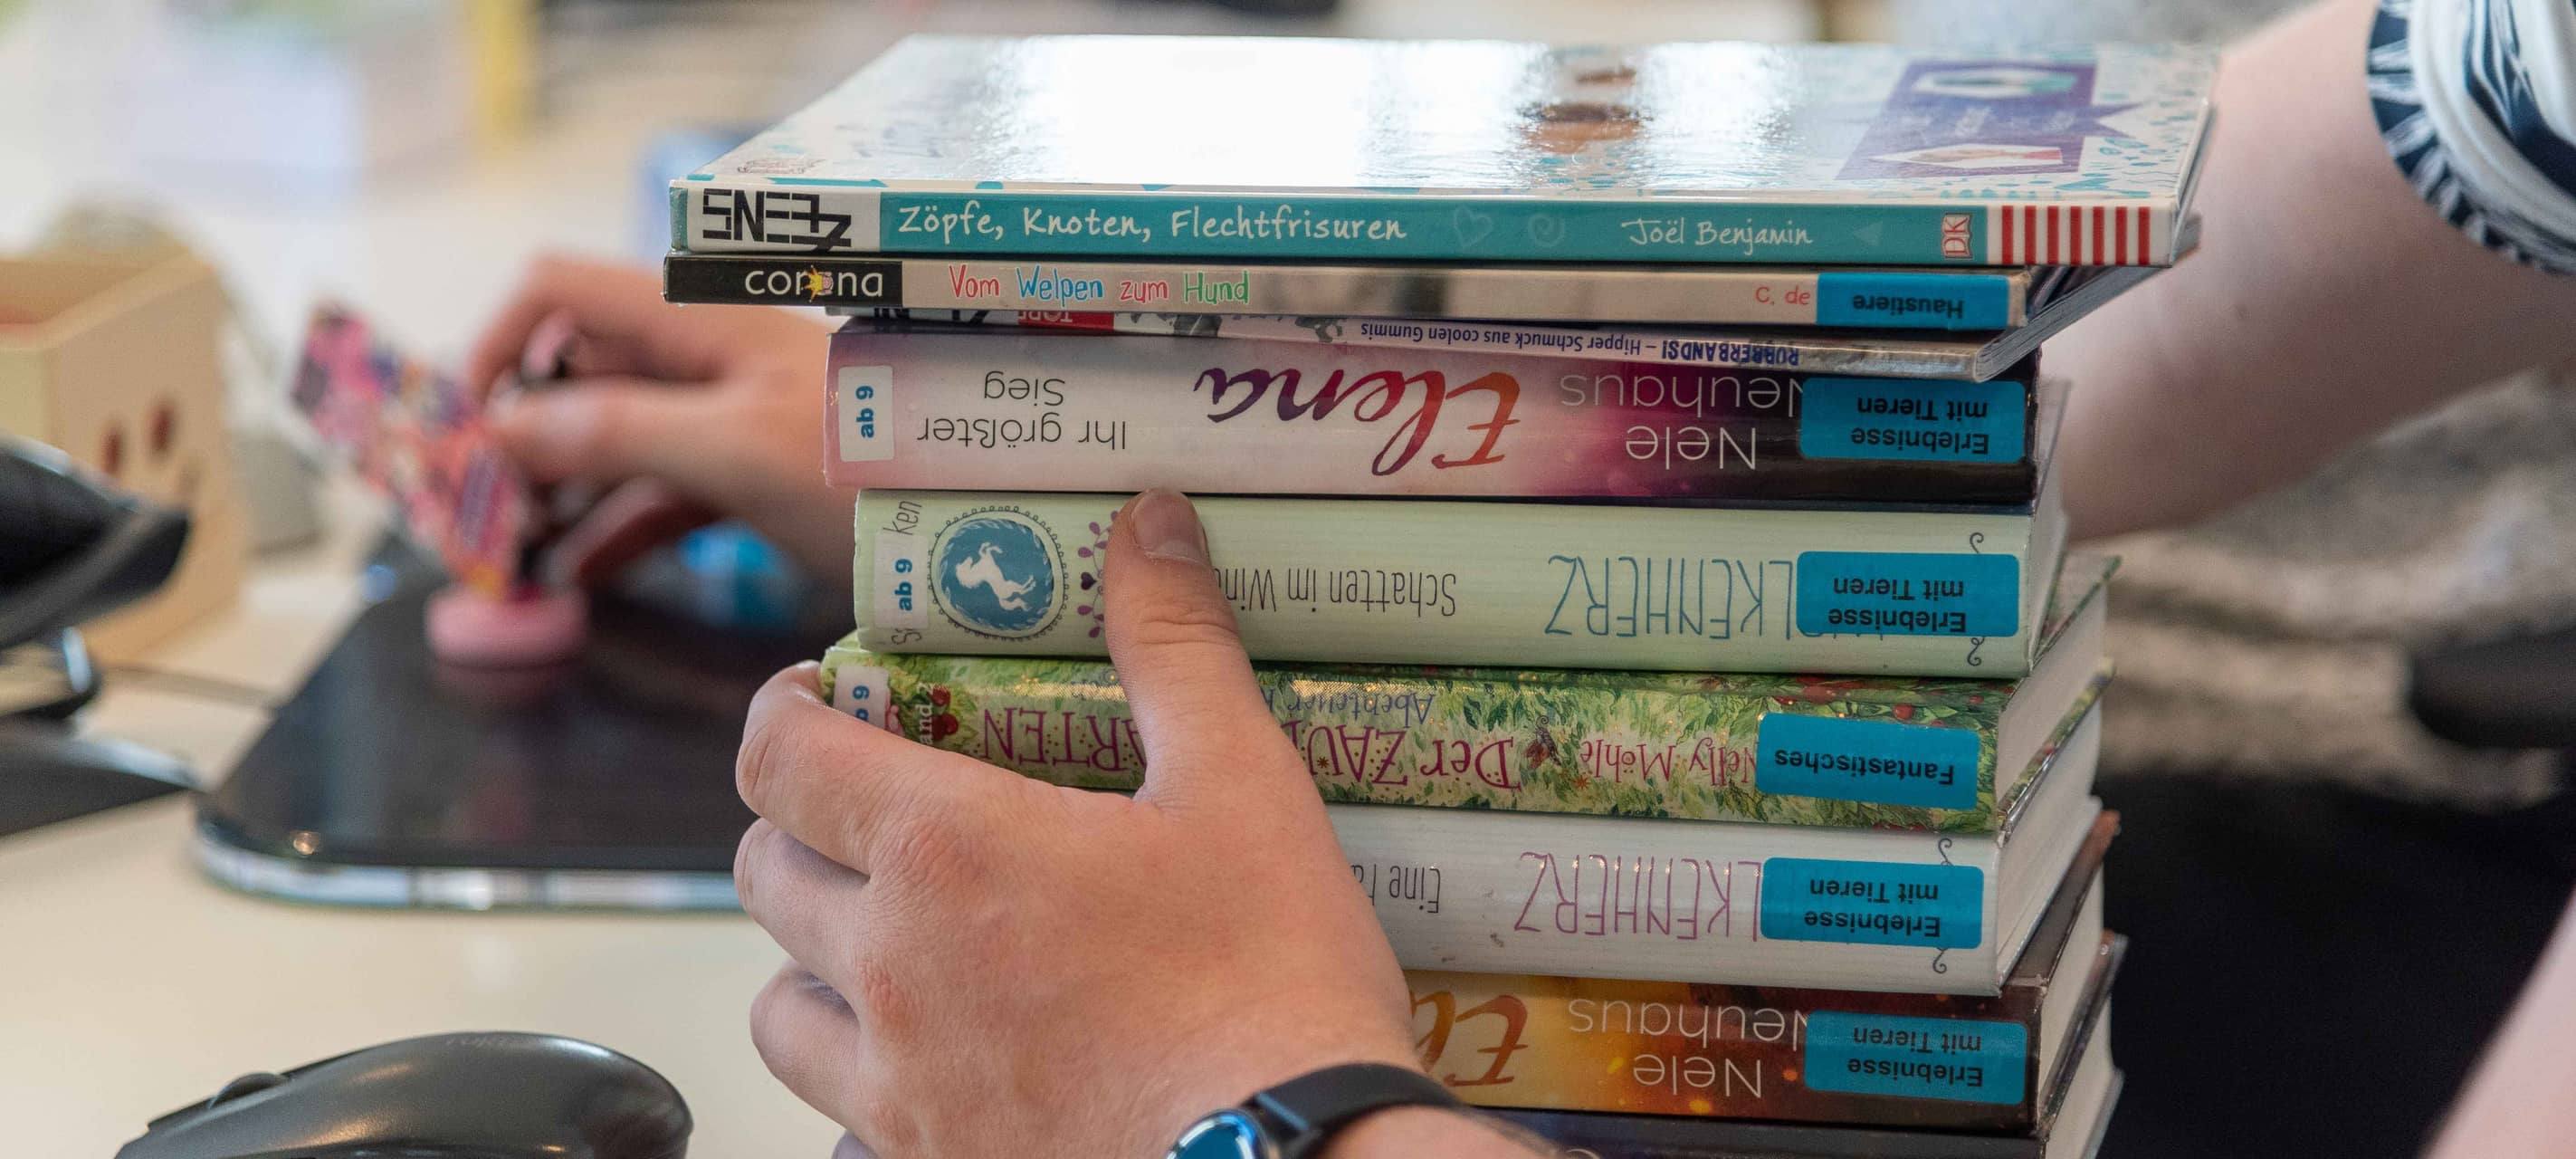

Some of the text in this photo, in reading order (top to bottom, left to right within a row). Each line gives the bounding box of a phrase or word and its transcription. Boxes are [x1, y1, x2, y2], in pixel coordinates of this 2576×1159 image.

[898, 200, 1407, 244] Zöpfe, Knoten, Flechtfrisuren
[1621, 217, 1814, 255] Joël Benjamin
[1943, 216, 1970, 256] DK
[948, 264, 1251, 308] Vom Welpen zum Hund
[1754, 286, 1776, 306] C.
[1852, 294, 1964, 320] Haustiere
[1360, 321, 1423, 342] Gummis
[1427, 327, 1480, 343] coolen
[1484, 330, 1511, 345] aus
[1514, 331, 1583, 352] Schmuck
[1587, 337, 1641, 356] Hipper
[1662, 340, 1799, 365] RUBBERBANDS!
[984, 370, 1066, 407] Sieg
[855, 385, 875, 439] ab 9
[1193, 367, 1522, 476] Elena
[1856, 397, 1989, 421] mit Tieren
[916, 412, 1127, 451] Ihr größter
[1625, 425, 1757, 471] Nele
[1850, 427, 1989, 455] Erlebnisse
[894, 558, 913, 573] 9
[894, 580, 913, 611] ab
[1287, 567, 1317, 613] im
[1329, 569, 1456, 618] Schatten
[1544, 555, 1794, 641] LKENHERZ
[1833, 578, 1965, 601] mit Tieren
[1828, 608, 1967, 634] Erlebnisse
[915, 703, 934, 745] and
[1287, 691, 1436, 729] Abenteuer
[1419, 737, 1522, 791] Der
[1579, 739, 1676, 783] Möhle
[1774, 749, 1955, 786] Fantastisches
[1388, 863, 1442, 915] Eine
[1513, 850, 1761, 942] LKENHERZ
[1811, 878, 1939, 905] mit Tieren
[1804, 910, 1941, 938] Erlebnisse
[1853, 1027, 1982, 1054] mit Tieren
[1633, 1053, 1762, 1099] Nele
[1847, 1058, 1983, 1087] Erlebnisse
